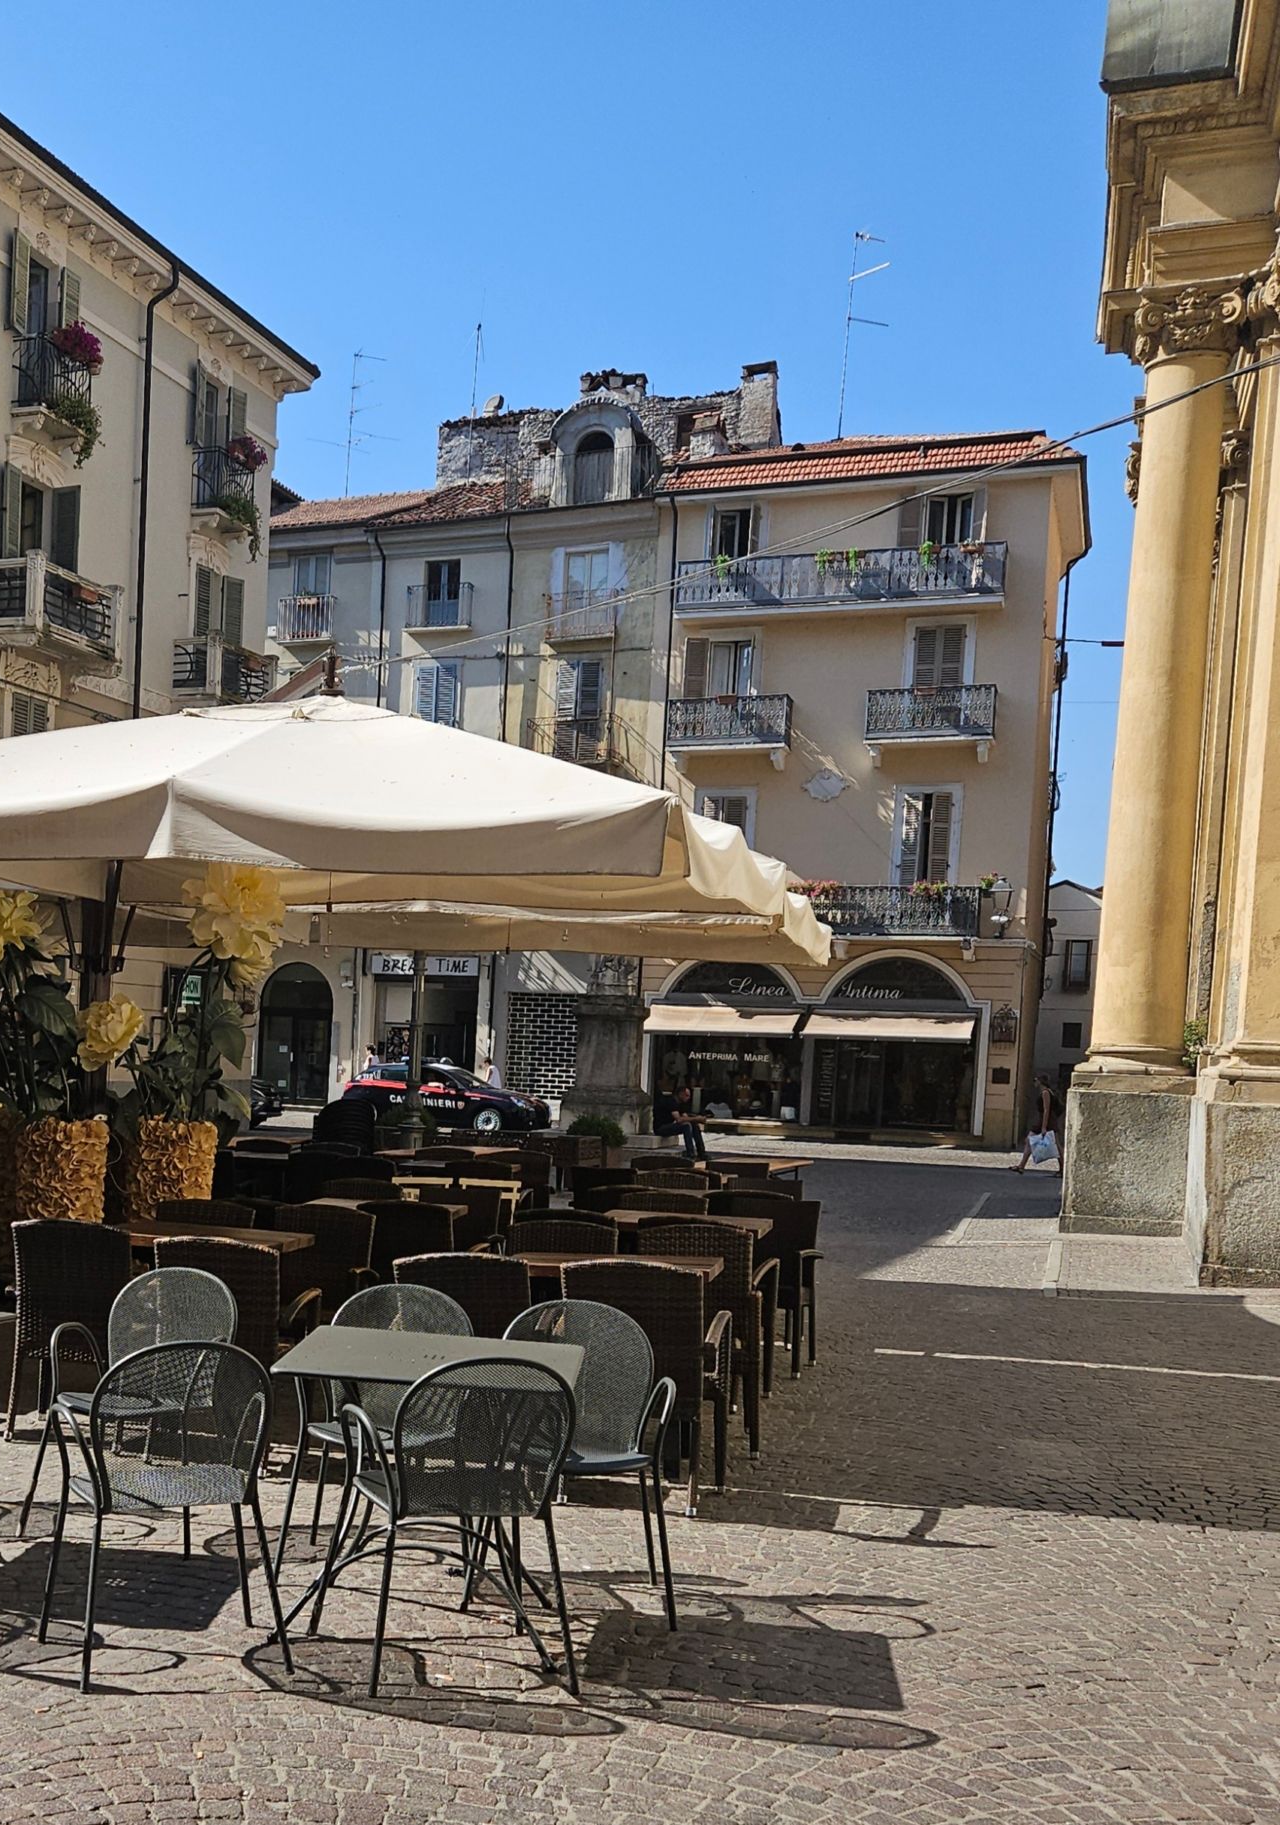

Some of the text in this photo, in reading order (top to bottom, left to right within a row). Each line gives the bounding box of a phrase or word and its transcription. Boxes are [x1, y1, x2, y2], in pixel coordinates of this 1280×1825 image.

[728, 976, 789, 996] Linea
[838, 980, 904, 1000] Intima
[743, 1053, 769, 1063] MARE
